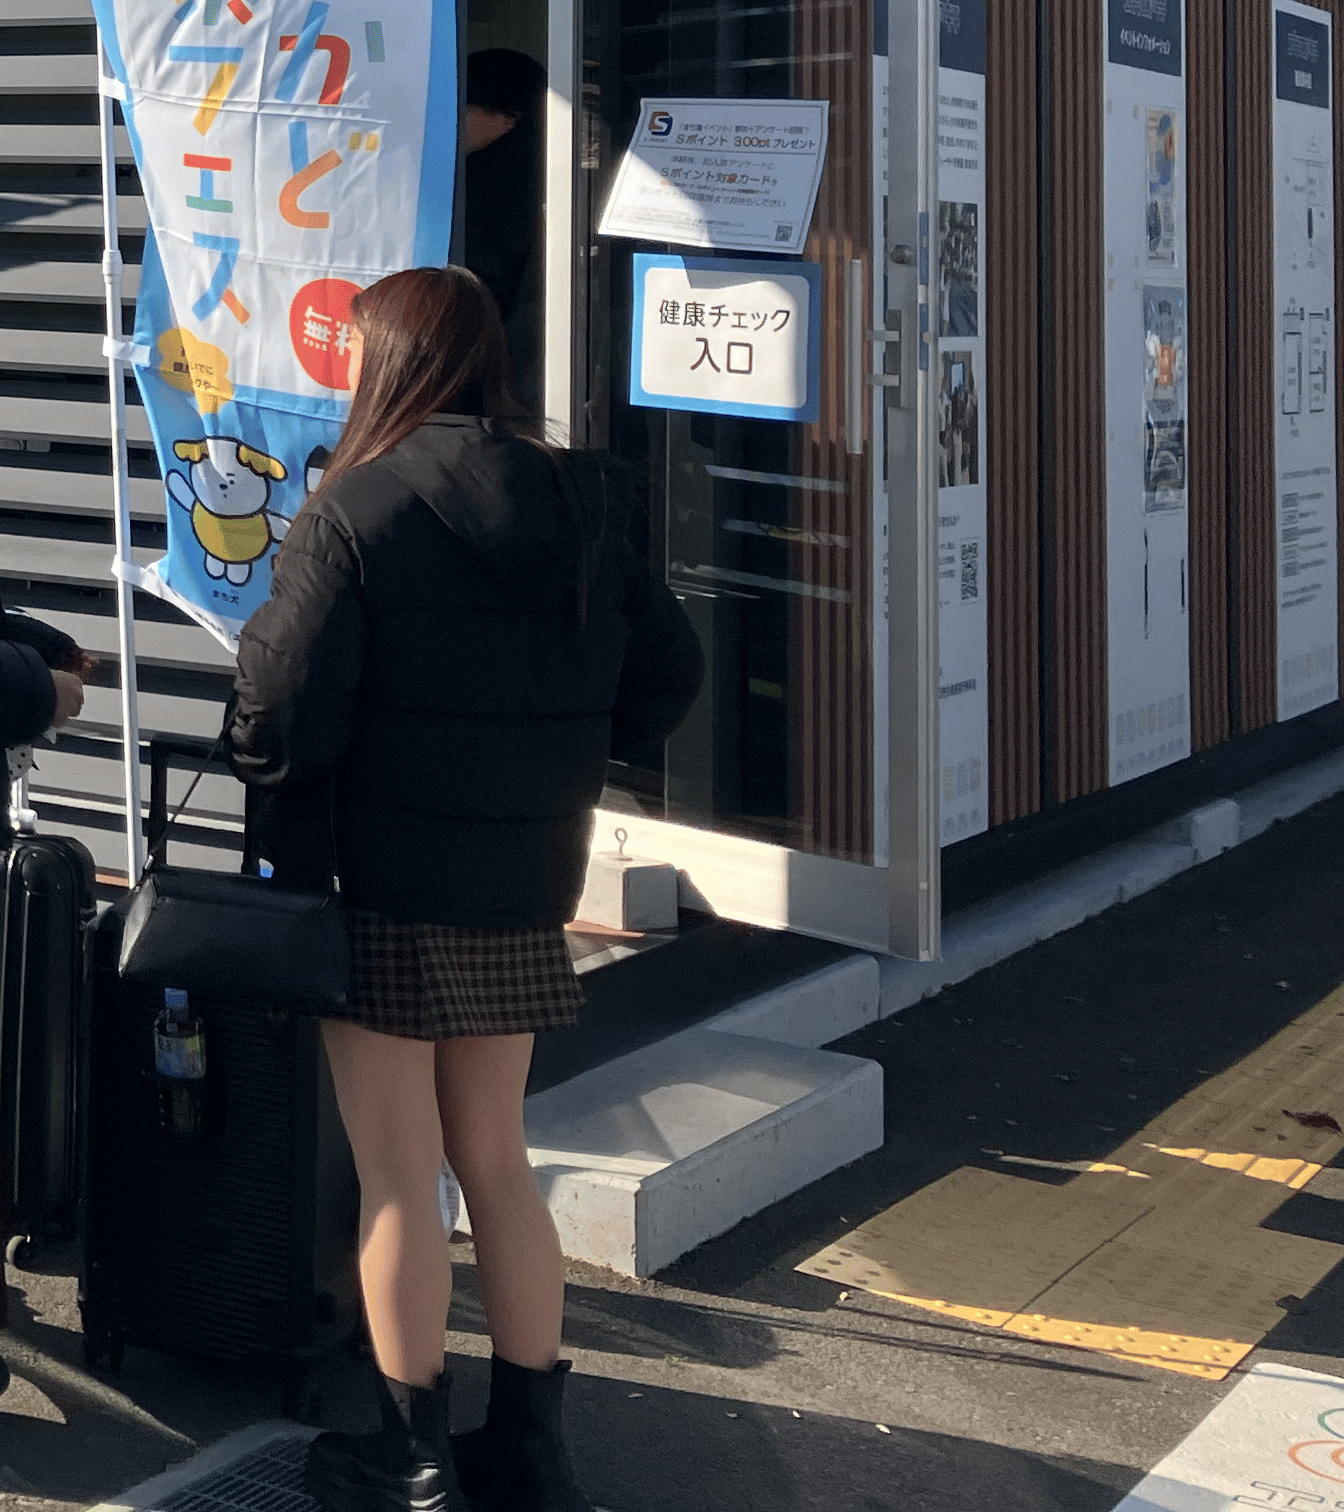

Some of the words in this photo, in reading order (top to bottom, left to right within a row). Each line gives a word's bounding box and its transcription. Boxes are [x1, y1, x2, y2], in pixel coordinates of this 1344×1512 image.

[659, 299, 791, 332] 健康チェック
[690, 337, 754, 375] 入口
